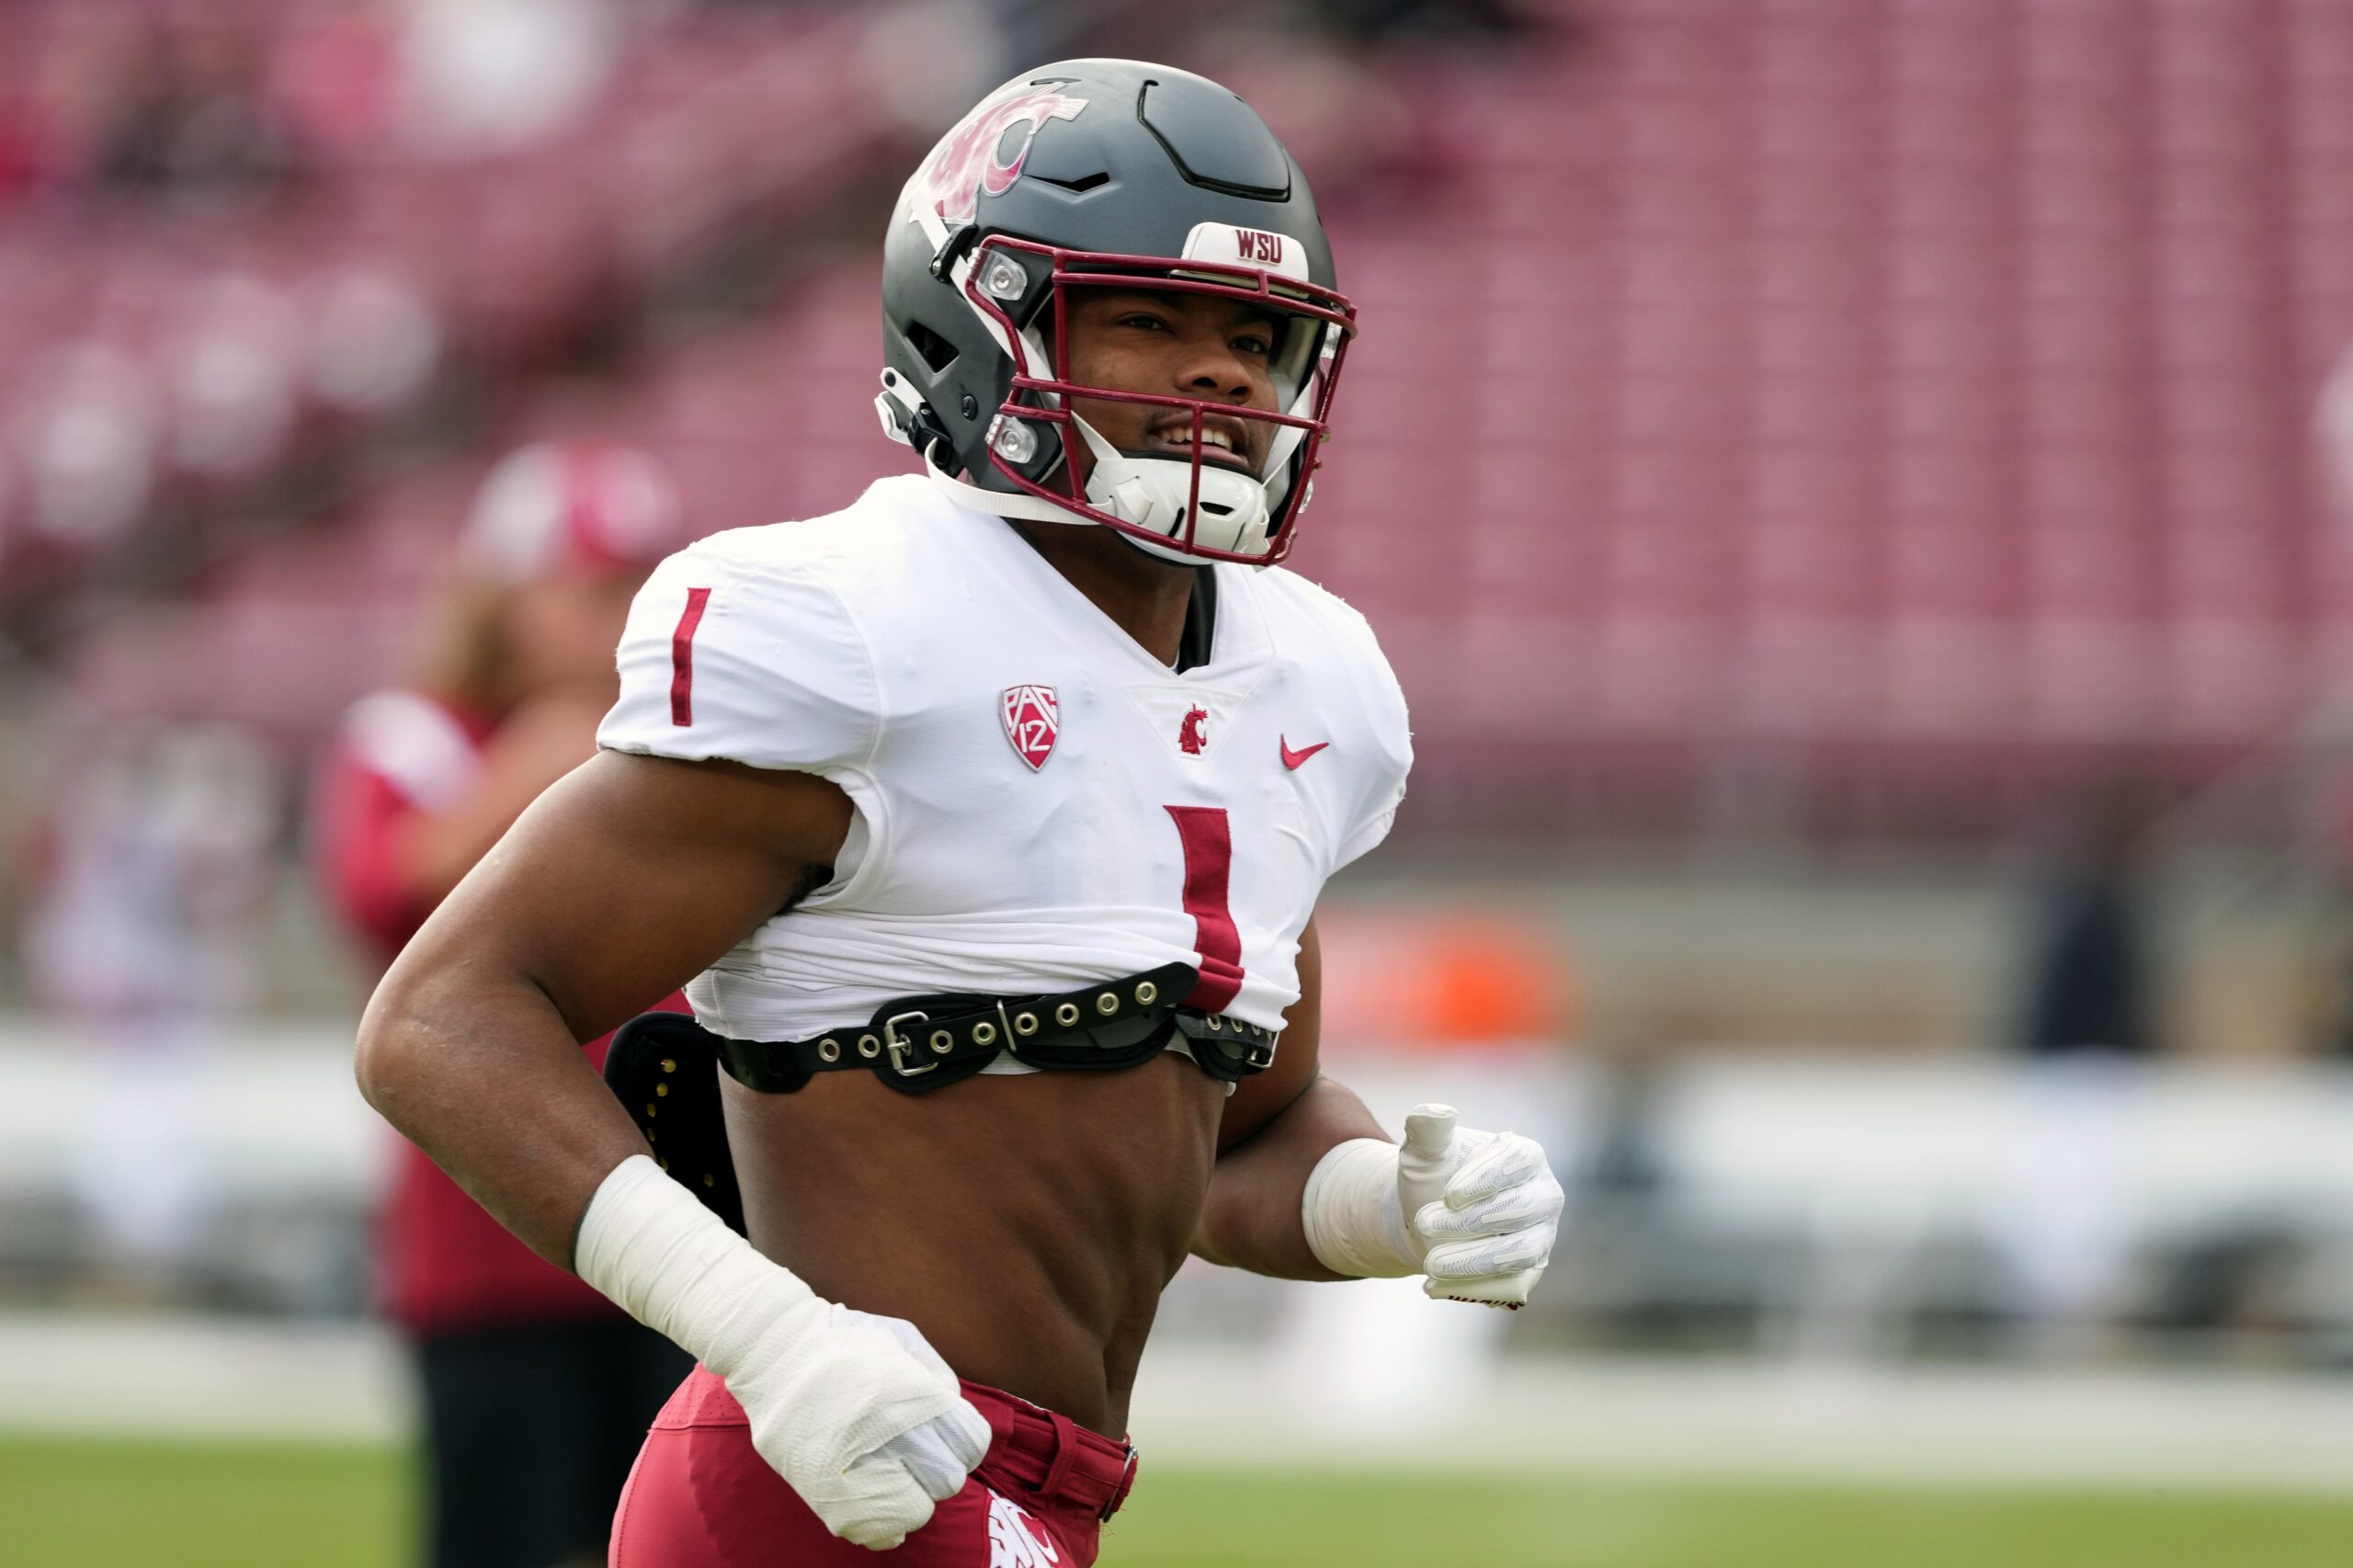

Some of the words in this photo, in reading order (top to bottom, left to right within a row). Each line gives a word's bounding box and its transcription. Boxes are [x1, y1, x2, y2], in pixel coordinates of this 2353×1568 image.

[1235, 229, 1282, 264] WSU
[670, 587, 712, 727] 1
[1003, 687, 1058, 737] PAC
[1018, 720, 1051, 753] 12
[1162, 805, 1245, 1015] 1
